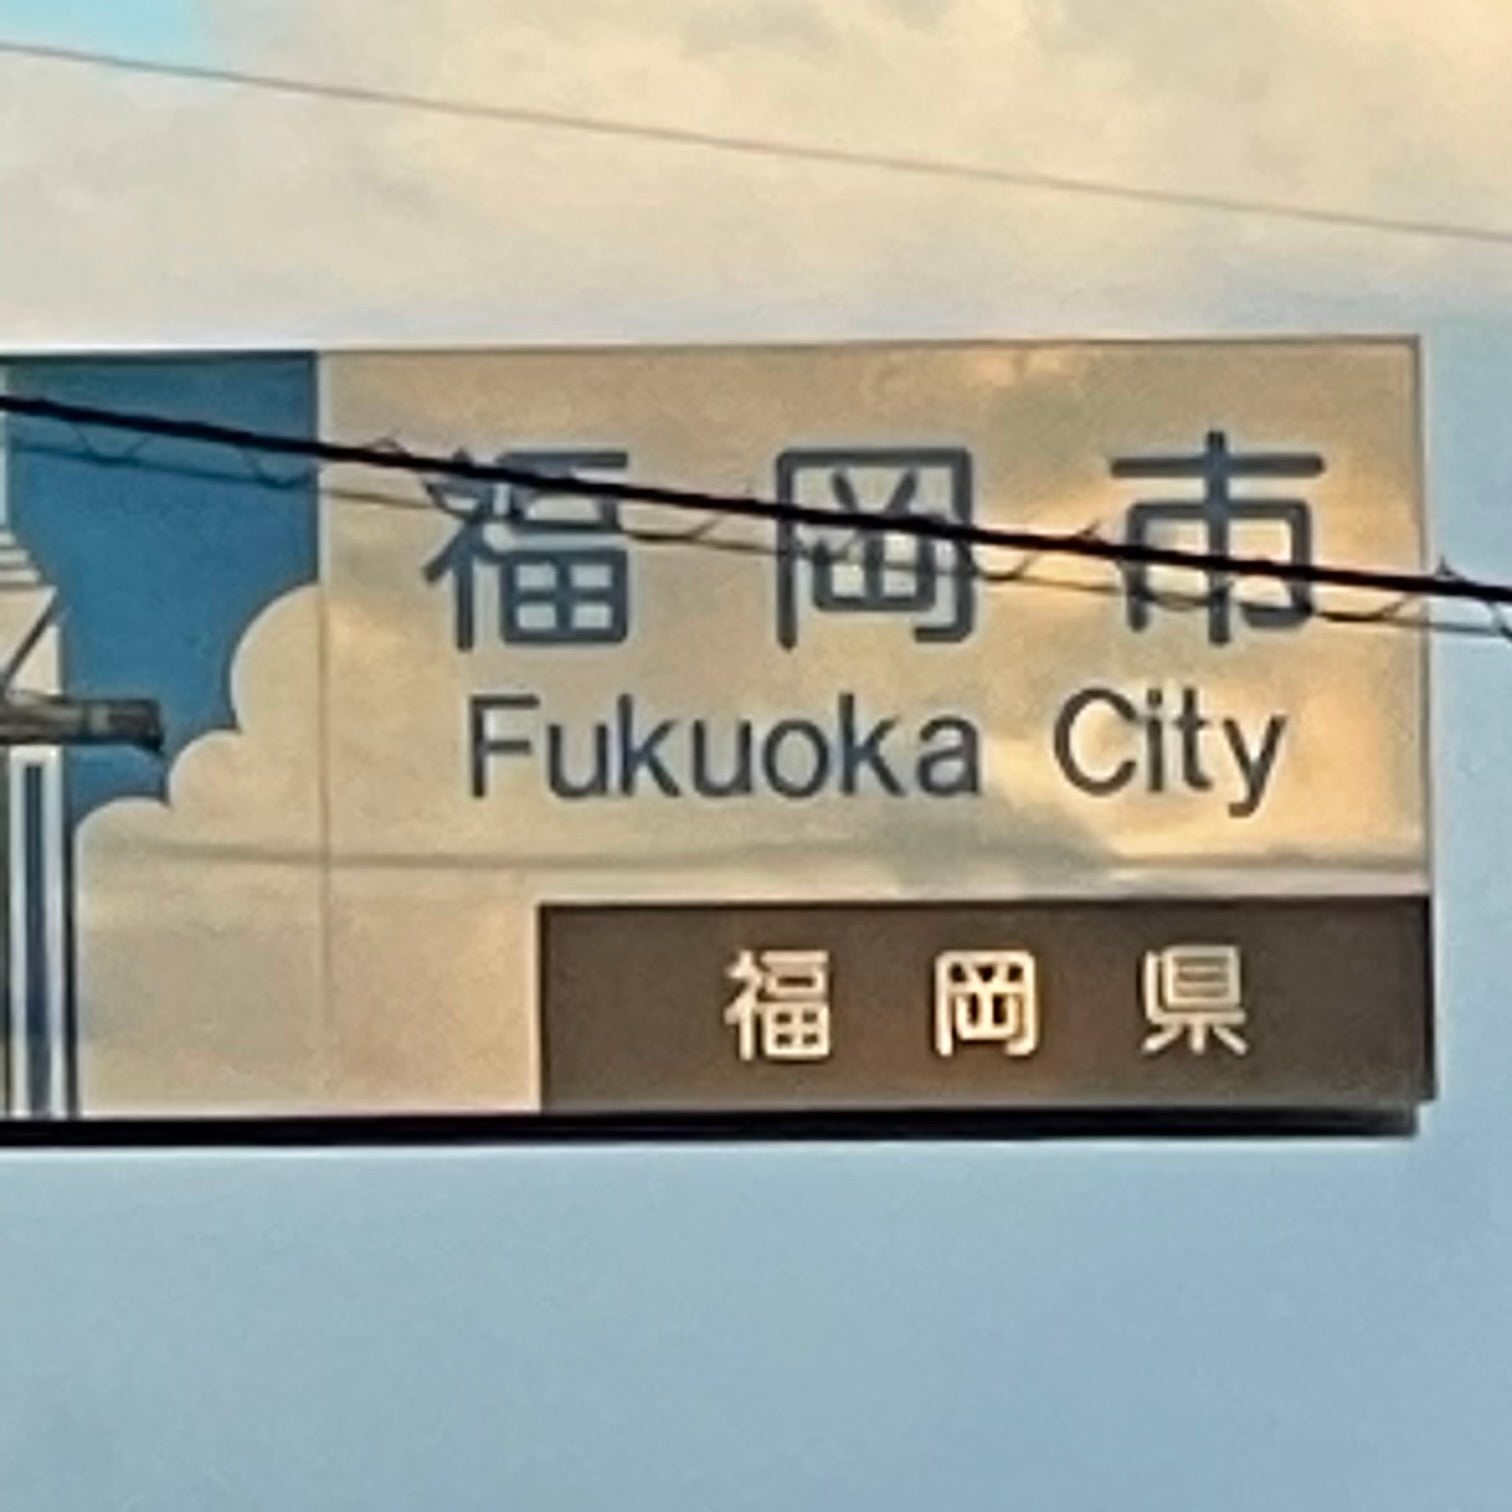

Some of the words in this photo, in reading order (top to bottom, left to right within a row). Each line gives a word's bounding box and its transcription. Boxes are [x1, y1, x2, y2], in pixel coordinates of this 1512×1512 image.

[420, 431, 1322, 651] 福岡市
[469, 693, 979, 799] Fukuoka
[1053, 687, 1285, 815] City
[725, 945, 1248, 1061] 福岡県
